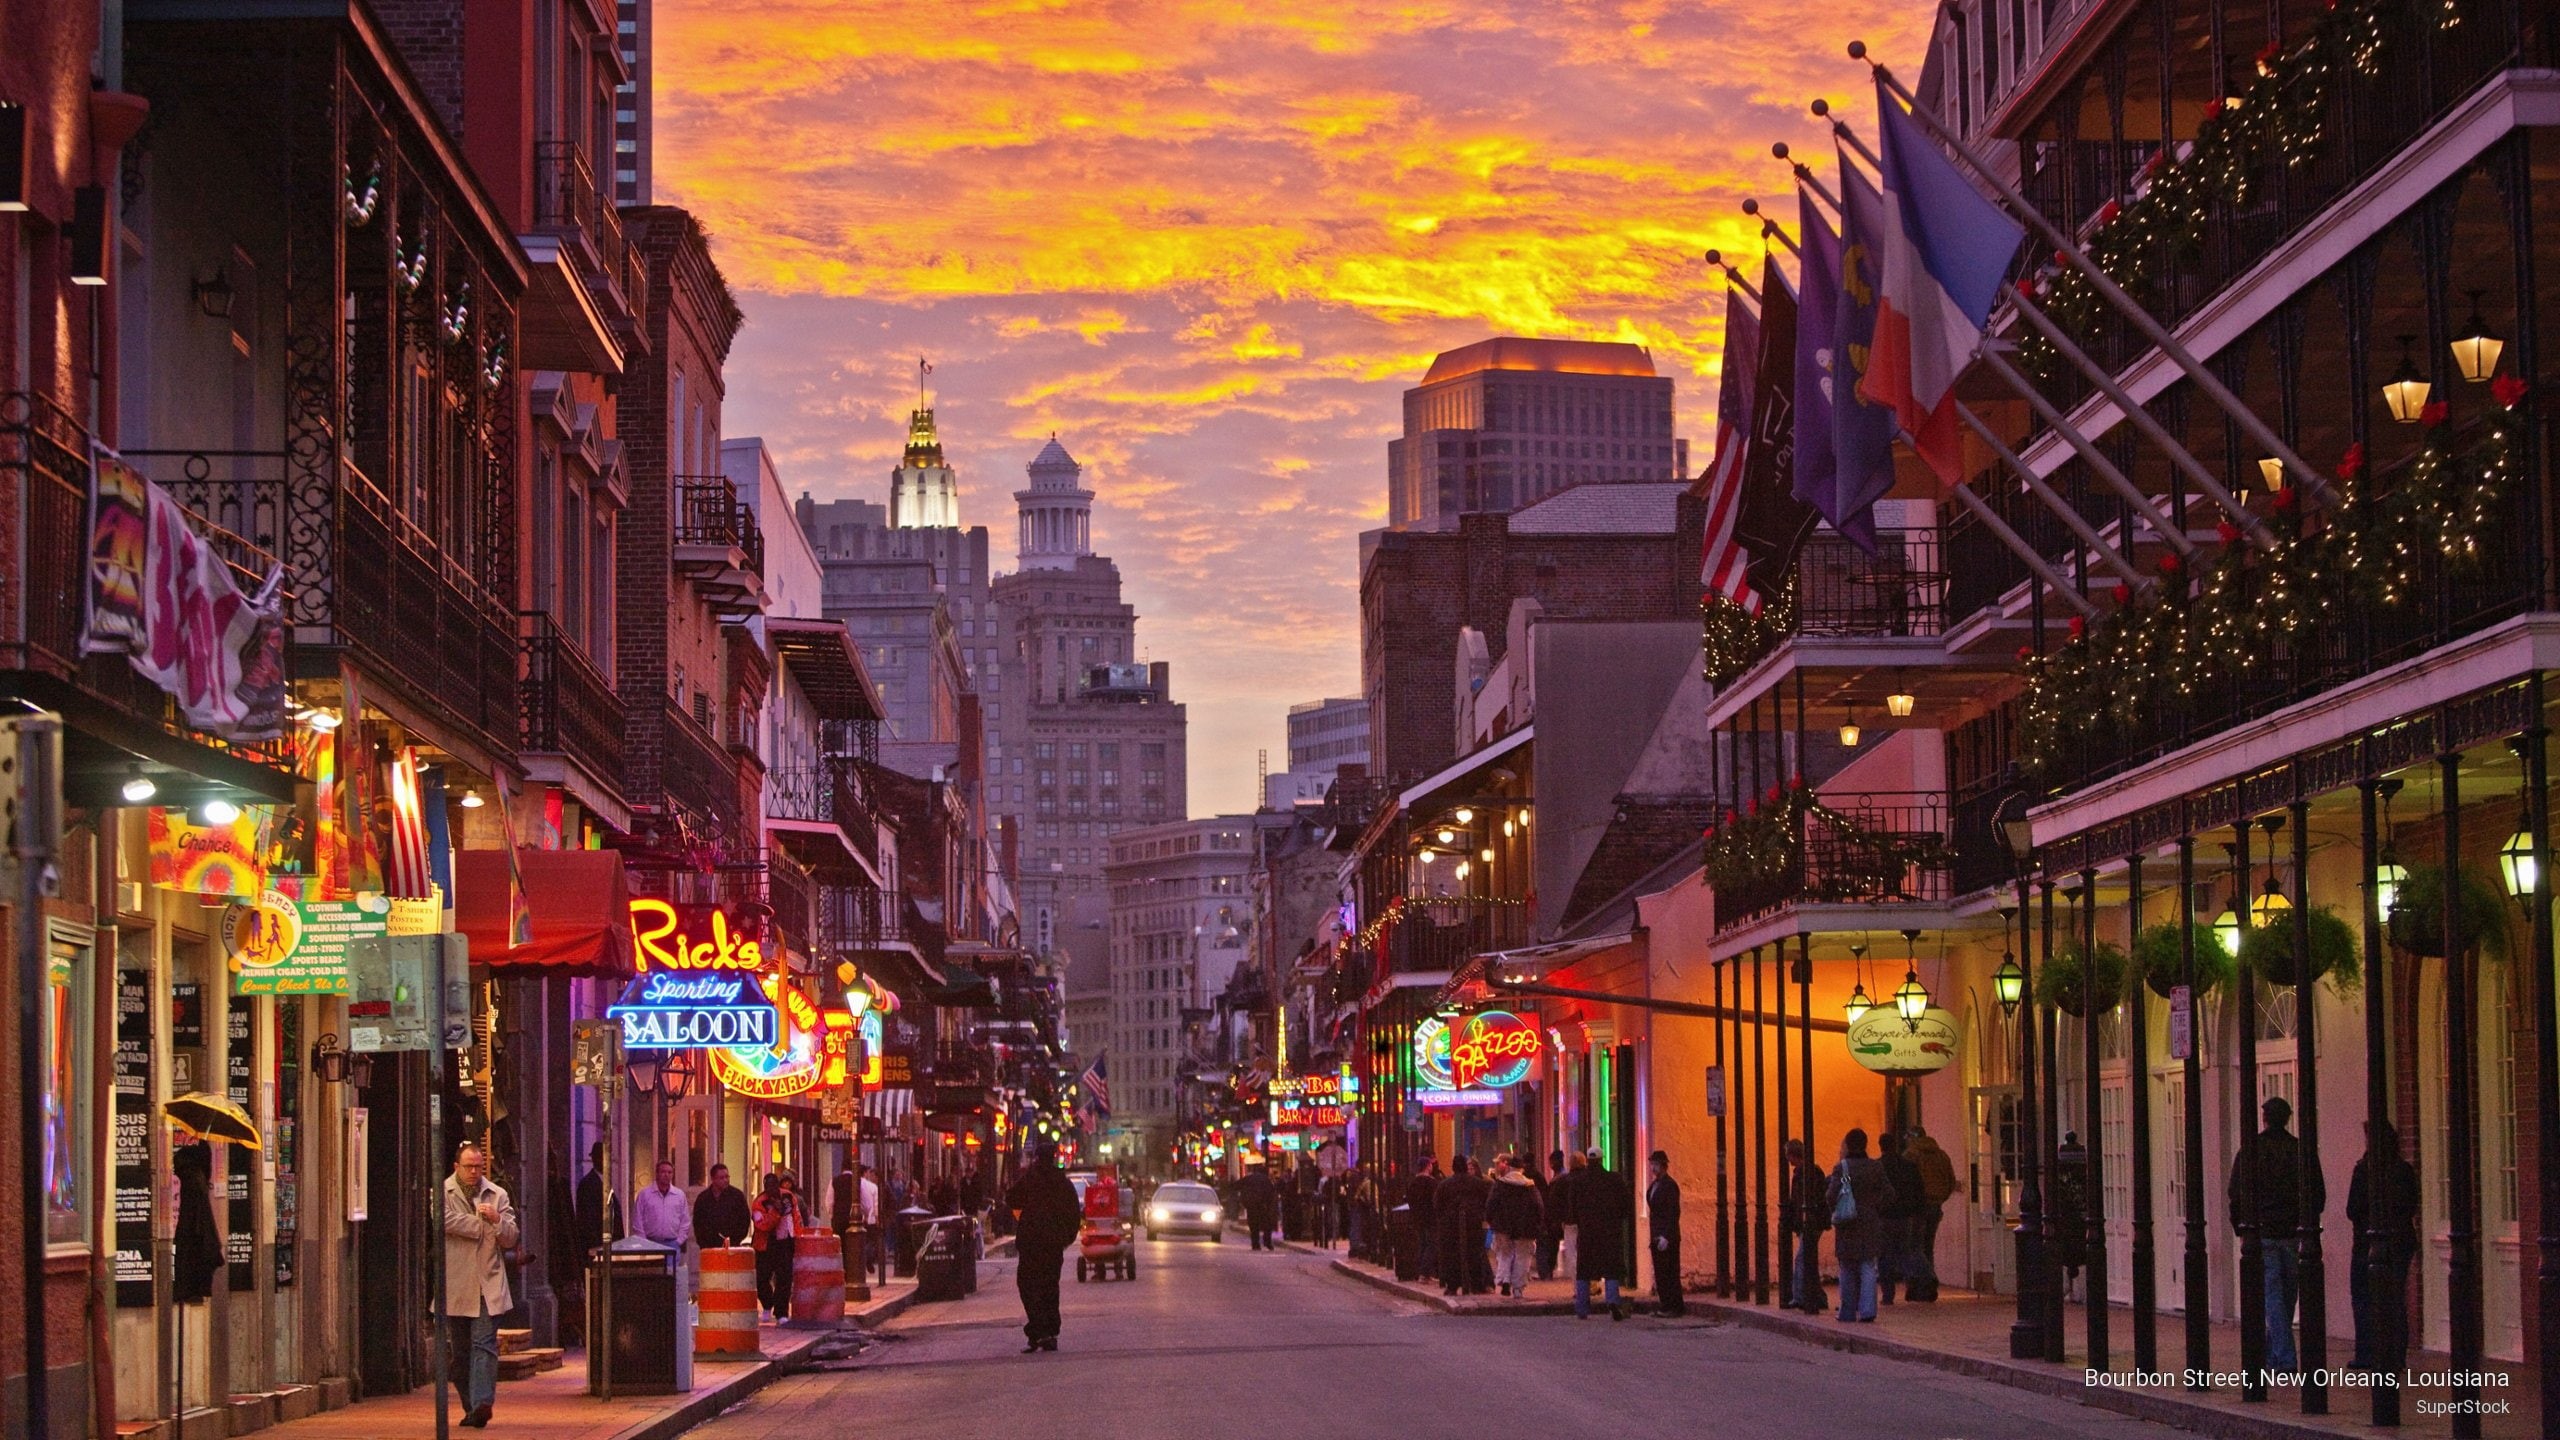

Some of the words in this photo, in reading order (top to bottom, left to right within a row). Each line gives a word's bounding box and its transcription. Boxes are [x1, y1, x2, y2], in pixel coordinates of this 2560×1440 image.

[306, 903, 343, 912] CLOTHING
[629, 899, 762, 972] Rick's
[1040, 909, 1048, 954] ASTO
[291, 956, 318, 965] SPORTS
[240, 968, 276, 977] PREMIUM
[276, 967, 306, 976] CIGARS
[309, 967, 331, 976] COLD
[241, 979, 273, 994] Come
[275, 977, 311, 993] Check
[643, 973, 743, 1004] Sporting
[622, 1010, 766, 1044] SALOON
[884, 1056, 908, 1067] RIS
[722, 1066, 765, 1094] BACK
[769, 1073, 809, 1095] YARD
[884, 1070, 912, 1081] ENS
[230, 1087, 247, 1096] REET
[1463, 1093, 1498, 1101] DINING
[116, 1113, 147, 1125] ESUS
[118, 1137, 142, 1147] OU!
[116, 1250, 142, 1260] EMA
